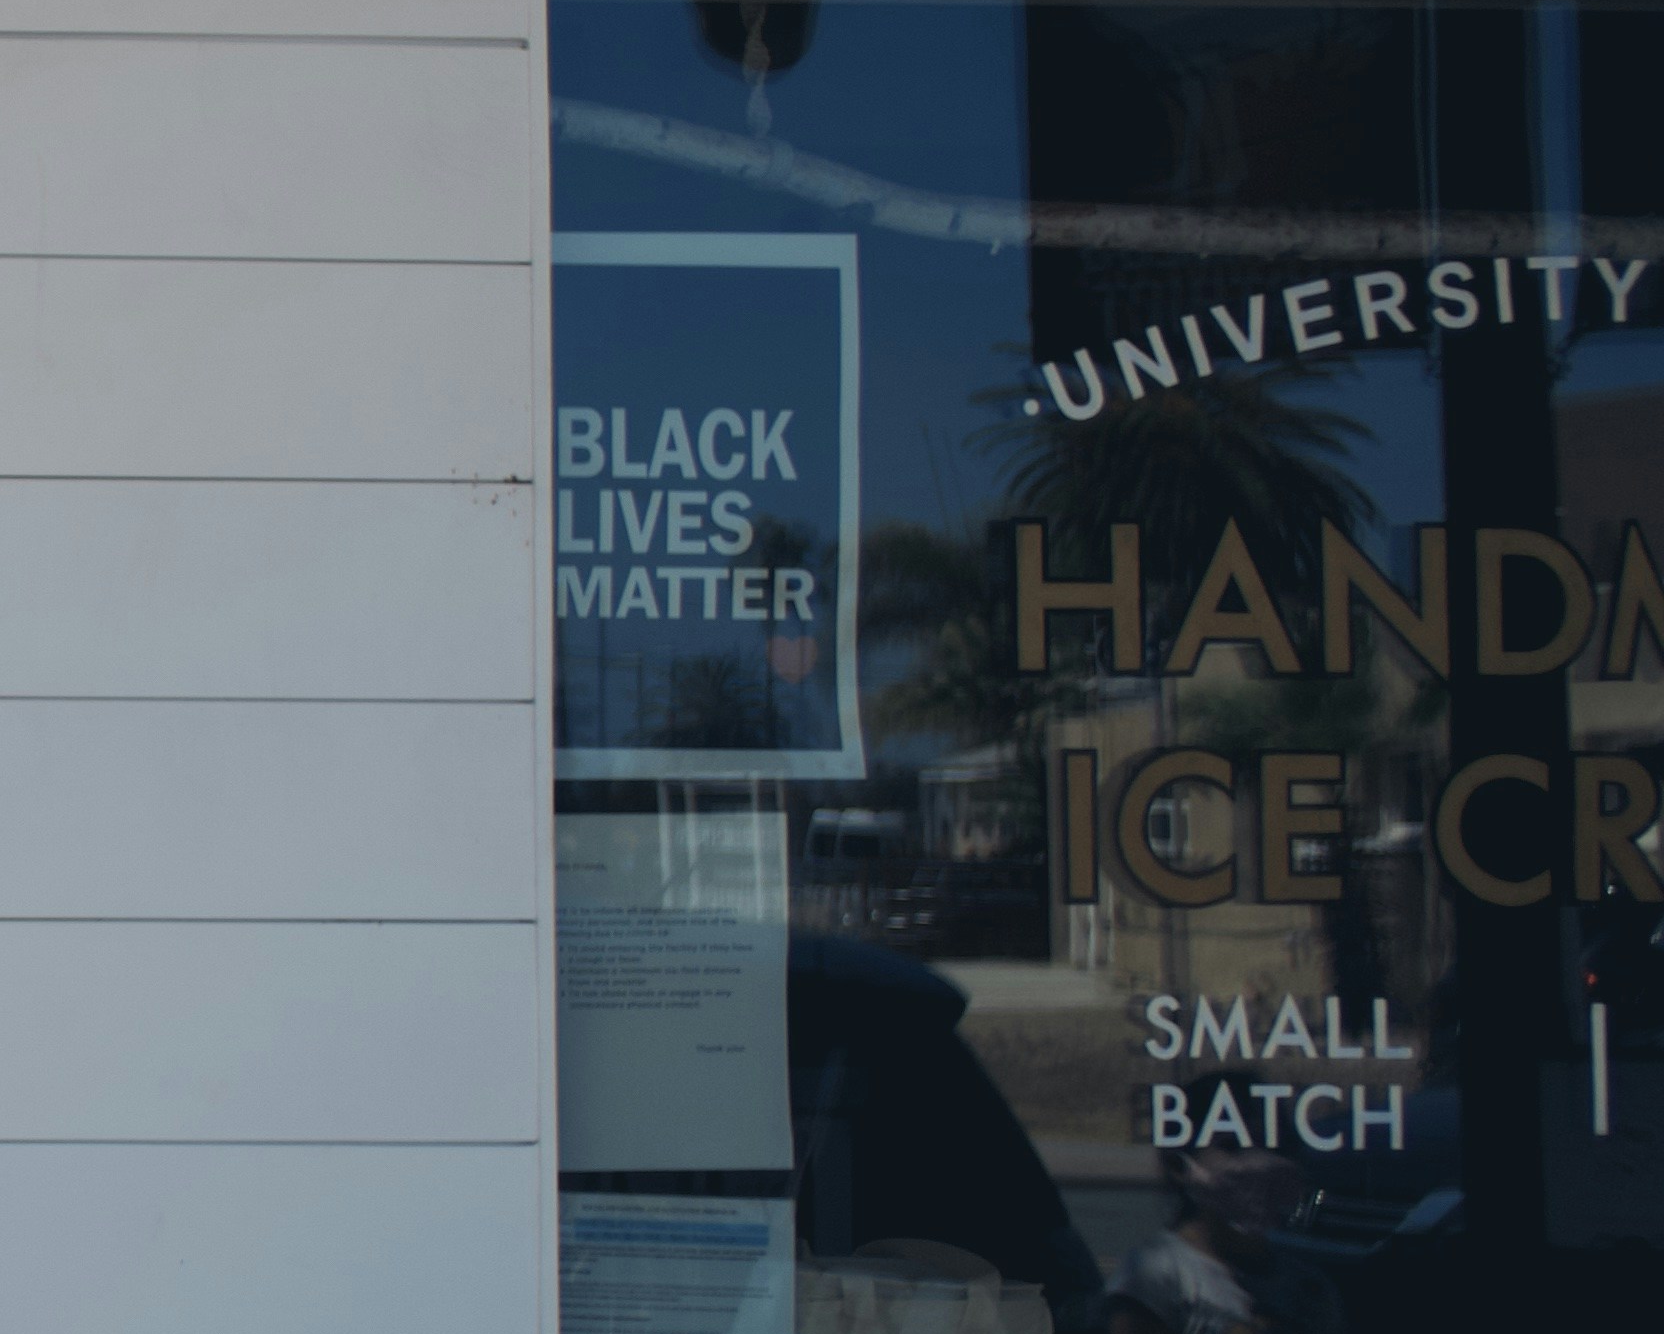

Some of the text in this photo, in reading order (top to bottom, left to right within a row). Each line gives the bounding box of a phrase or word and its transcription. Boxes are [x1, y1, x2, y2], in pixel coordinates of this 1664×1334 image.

[1038, 255, 1647, 424] UNIVERSITY
[557, 406, 798, 481] BLACK
[557, 488, 755, 556] LIVES
[556, 565, 816, 621] MATTER
[1061, 746, 1346, 908] ICE
[1143, 993, 1414, 1061] SMALL
[1151, 1079, 1405, 1152] BATCH
